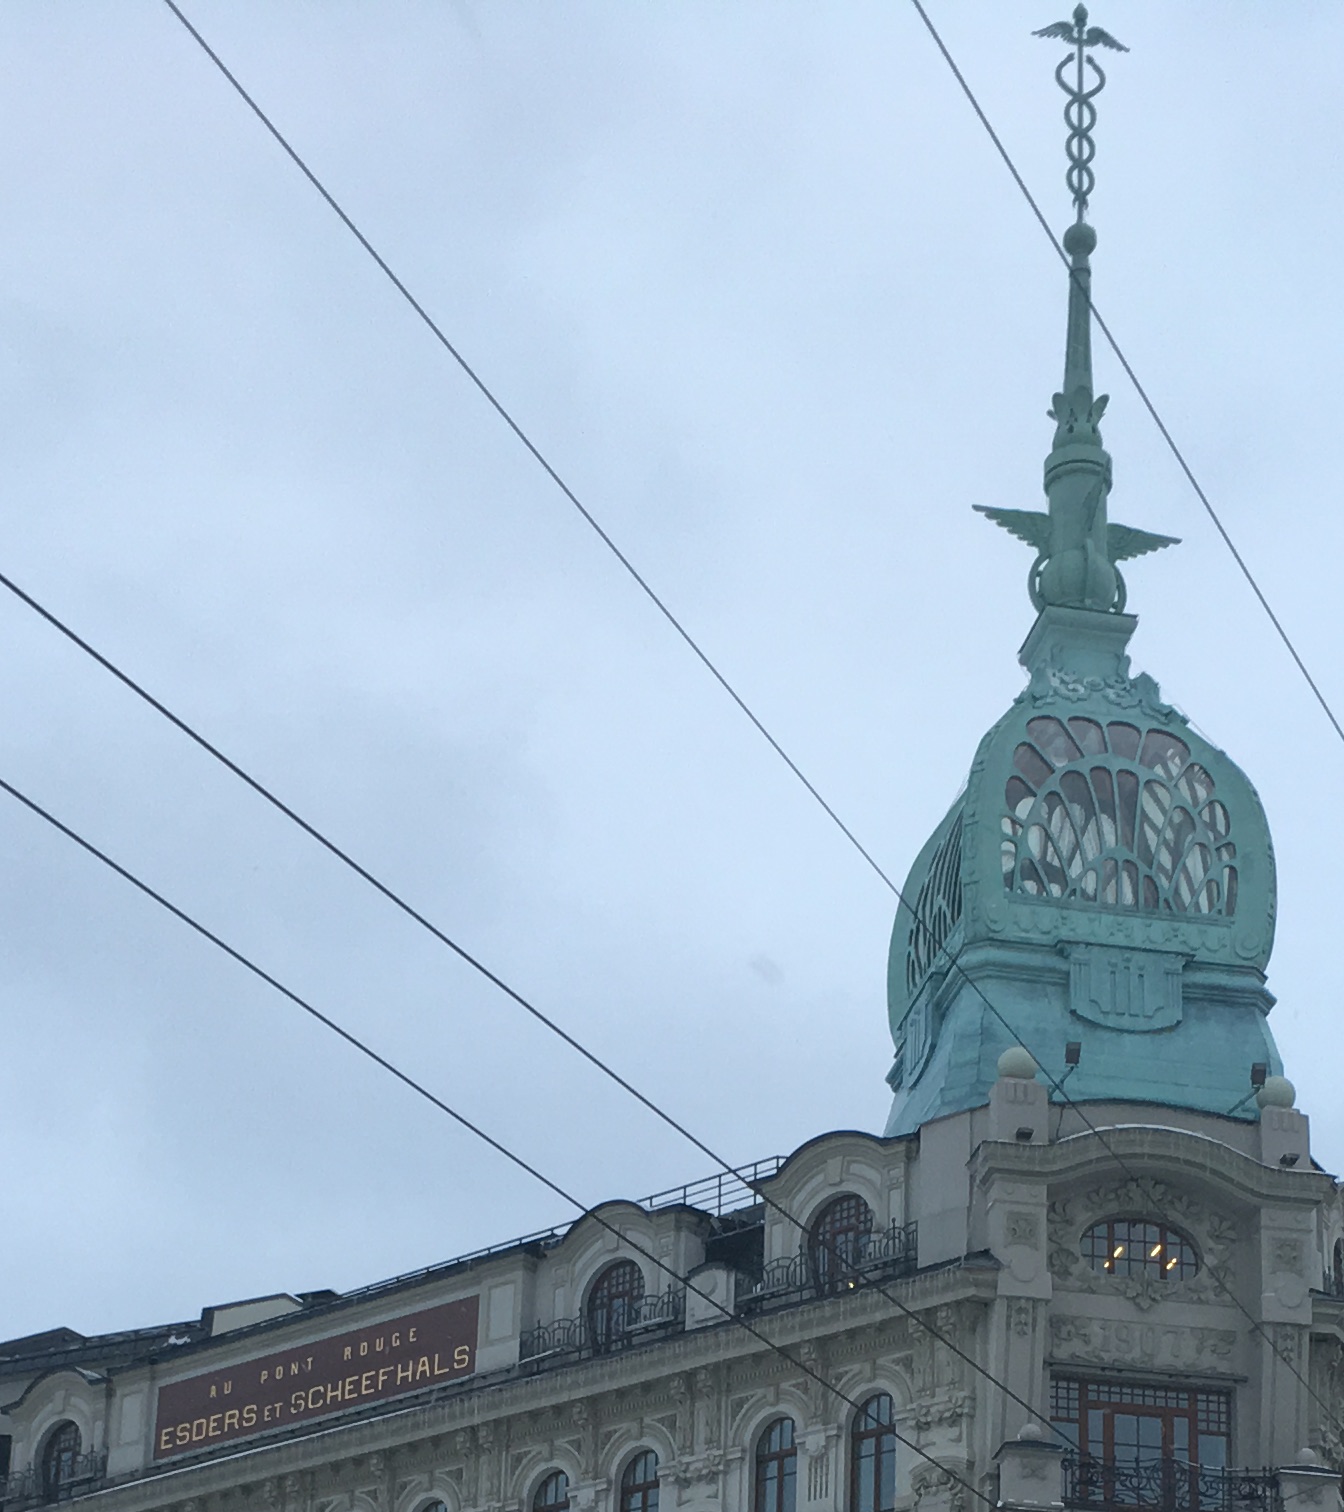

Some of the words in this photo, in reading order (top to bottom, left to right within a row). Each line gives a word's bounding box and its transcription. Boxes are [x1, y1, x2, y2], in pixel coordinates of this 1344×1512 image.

[209, 1381, 232, 1398] AU
[260, 1357, 314, 1384] PONT
[343, 1328, 417, 1361] ROUGE
[1099, 1322, 1185, 1358] 1907
[160, 1404, 258, 1450] ESDERS
[263, 1402, 283, 1421] ET
[290, 1345, 469, 1414] SCHEEFHALS
